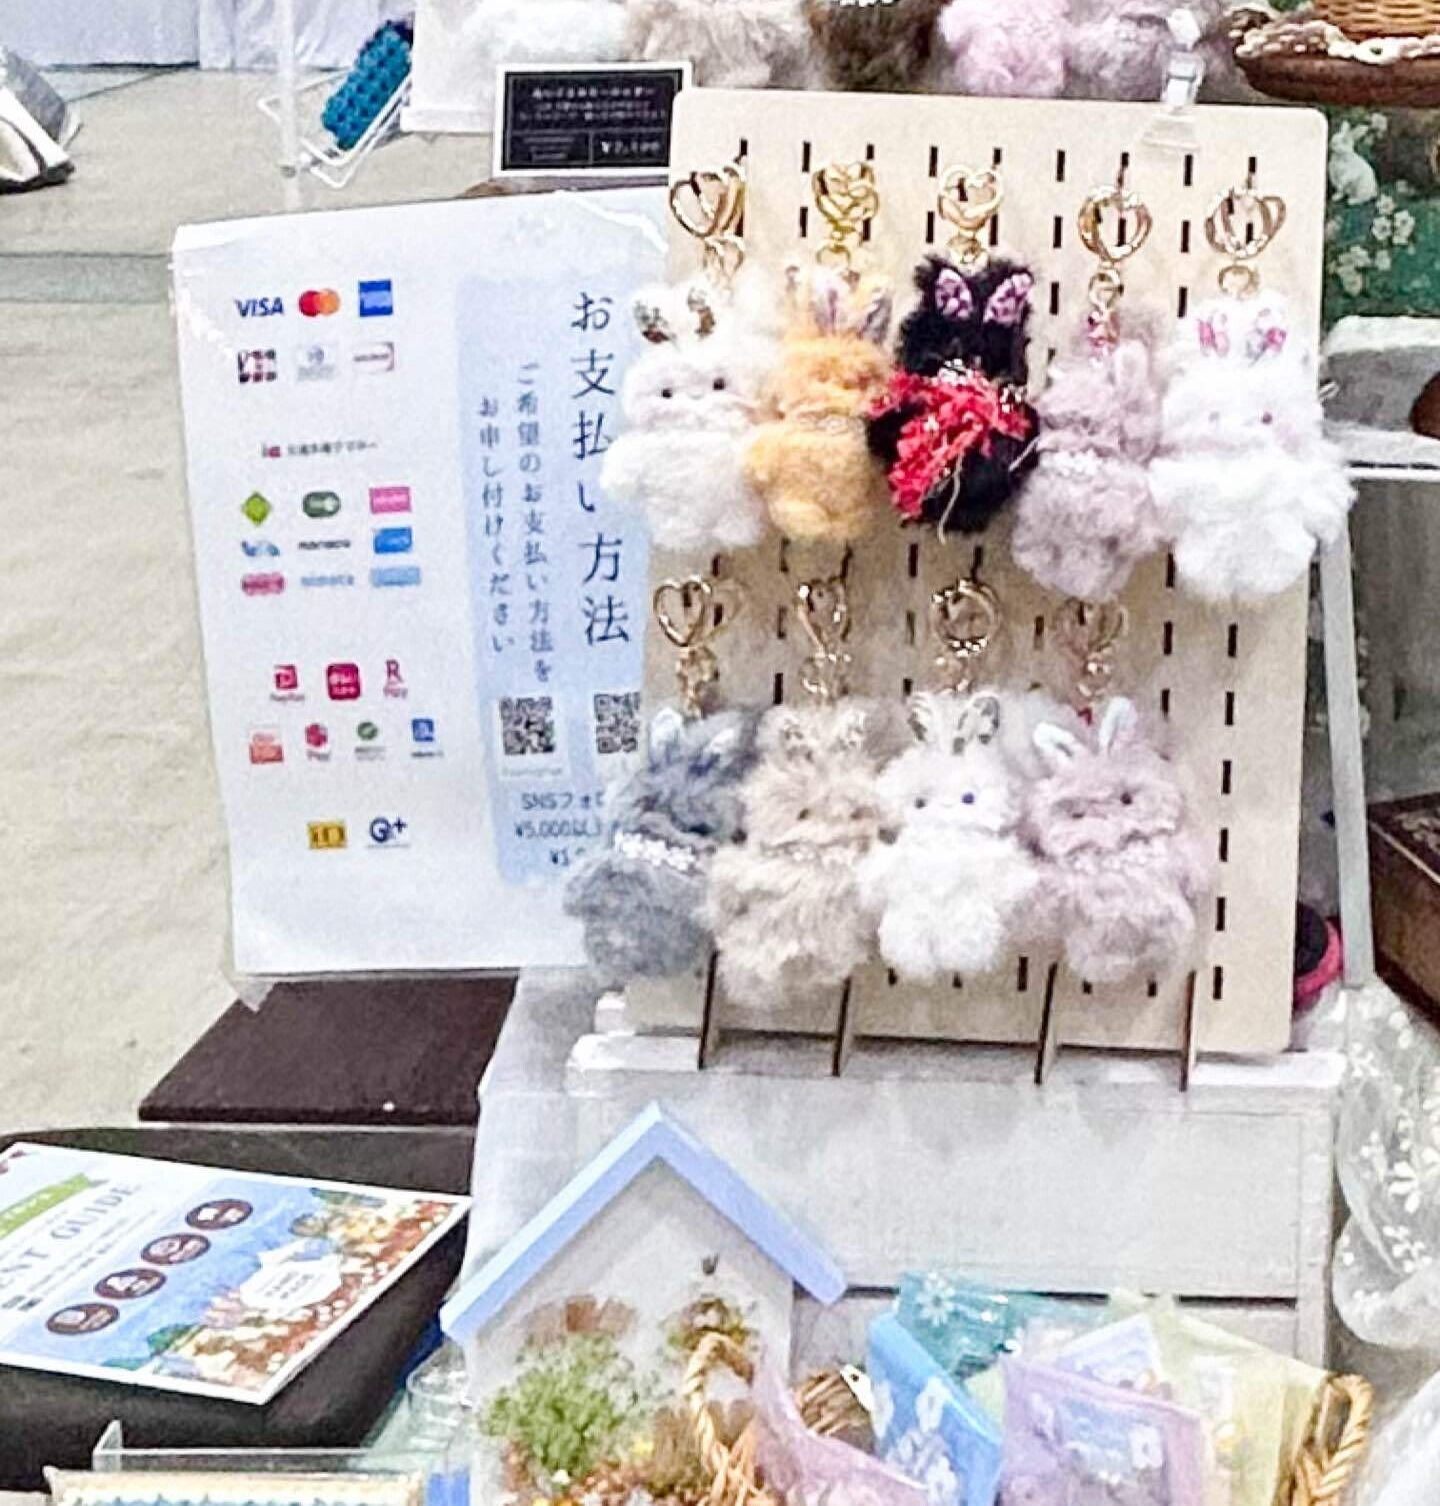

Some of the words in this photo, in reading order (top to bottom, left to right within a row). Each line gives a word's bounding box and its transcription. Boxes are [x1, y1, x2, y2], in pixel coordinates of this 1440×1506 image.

[234, 297, 285, 318] VISA
[477, 395, 516, 655] お申し付けください
[515, 361, 554, 684] ご希望のお支払い方法を
